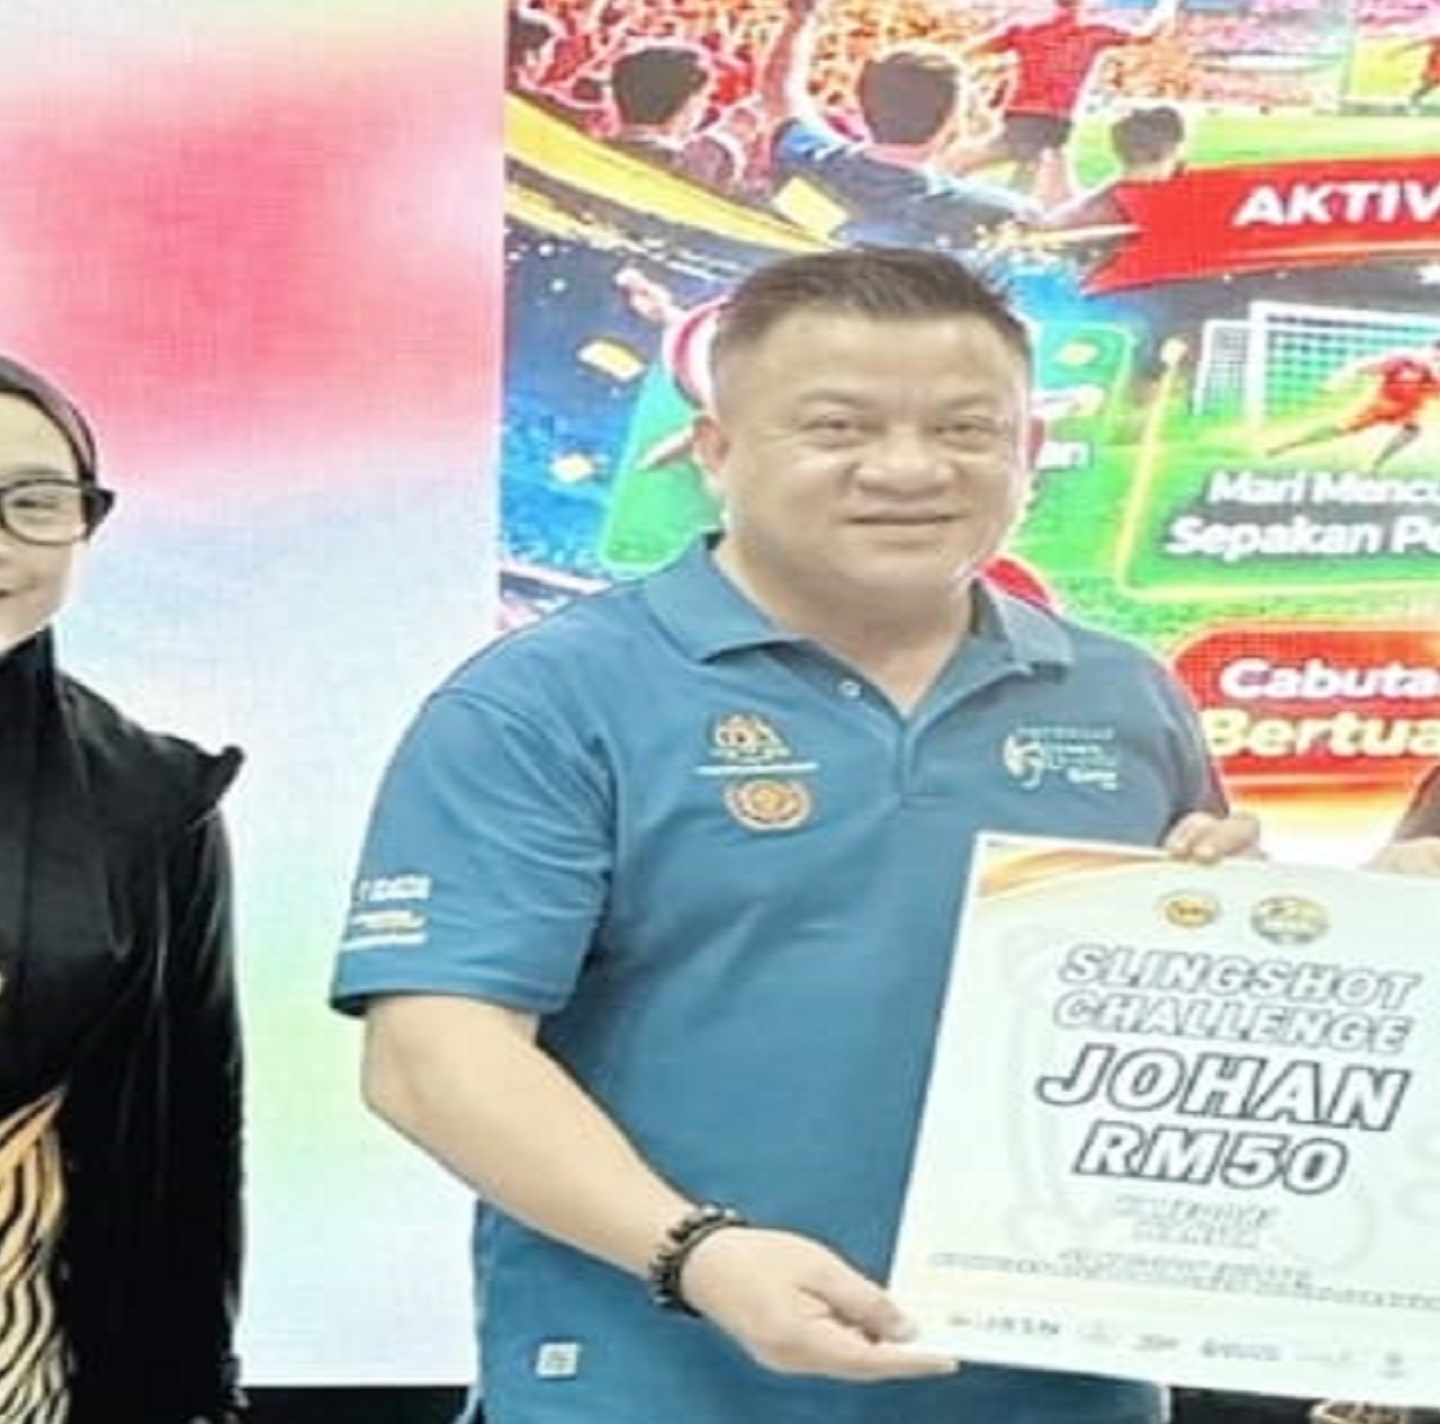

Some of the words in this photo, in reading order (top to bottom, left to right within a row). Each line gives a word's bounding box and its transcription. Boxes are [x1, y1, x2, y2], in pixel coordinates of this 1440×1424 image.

[1166, 515, 1380, 561] Sepakan
[1058, 943, 1421, 1011] SLINGSHOT
[1053, 988, 1412, 1054] CHALLENGE
[1035, 1043, 1410, 1131] JOHAN
[1071, 1121, 1348, 1195] RM50
